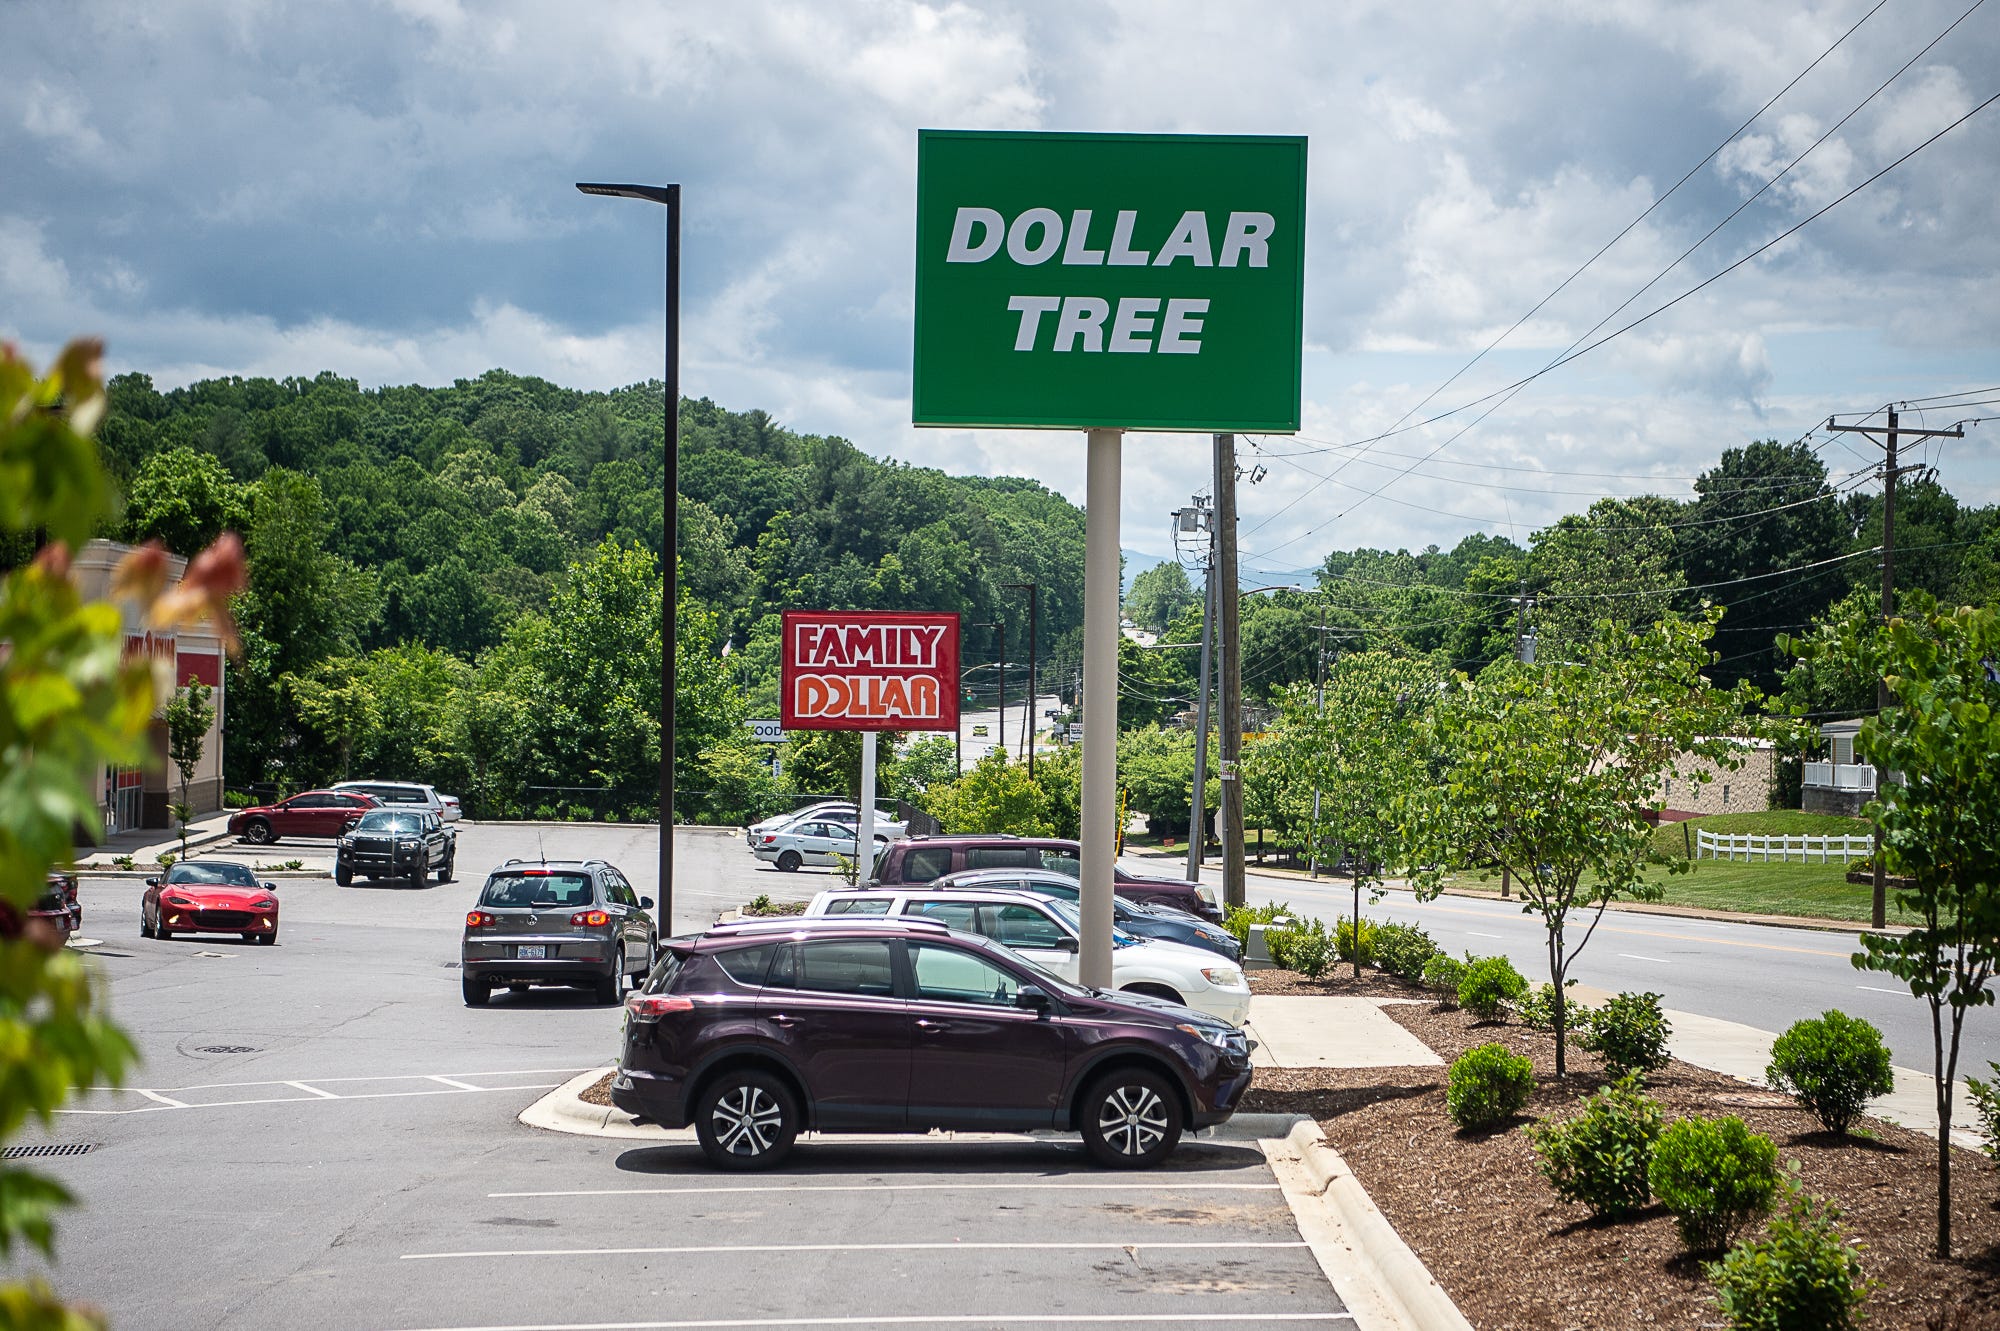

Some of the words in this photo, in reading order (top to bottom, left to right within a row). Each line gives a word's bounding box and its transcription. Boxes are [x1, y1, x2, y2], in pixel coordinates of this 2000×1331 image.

[946, 207, 1275, 268] DOLLAR
[1007, 296, 1210, 354] TREE
[795, 624, 947, 668] FAMILY
[795, 674, 940, 718] DOLLAR
[754, 726, 782, 736] OOD
